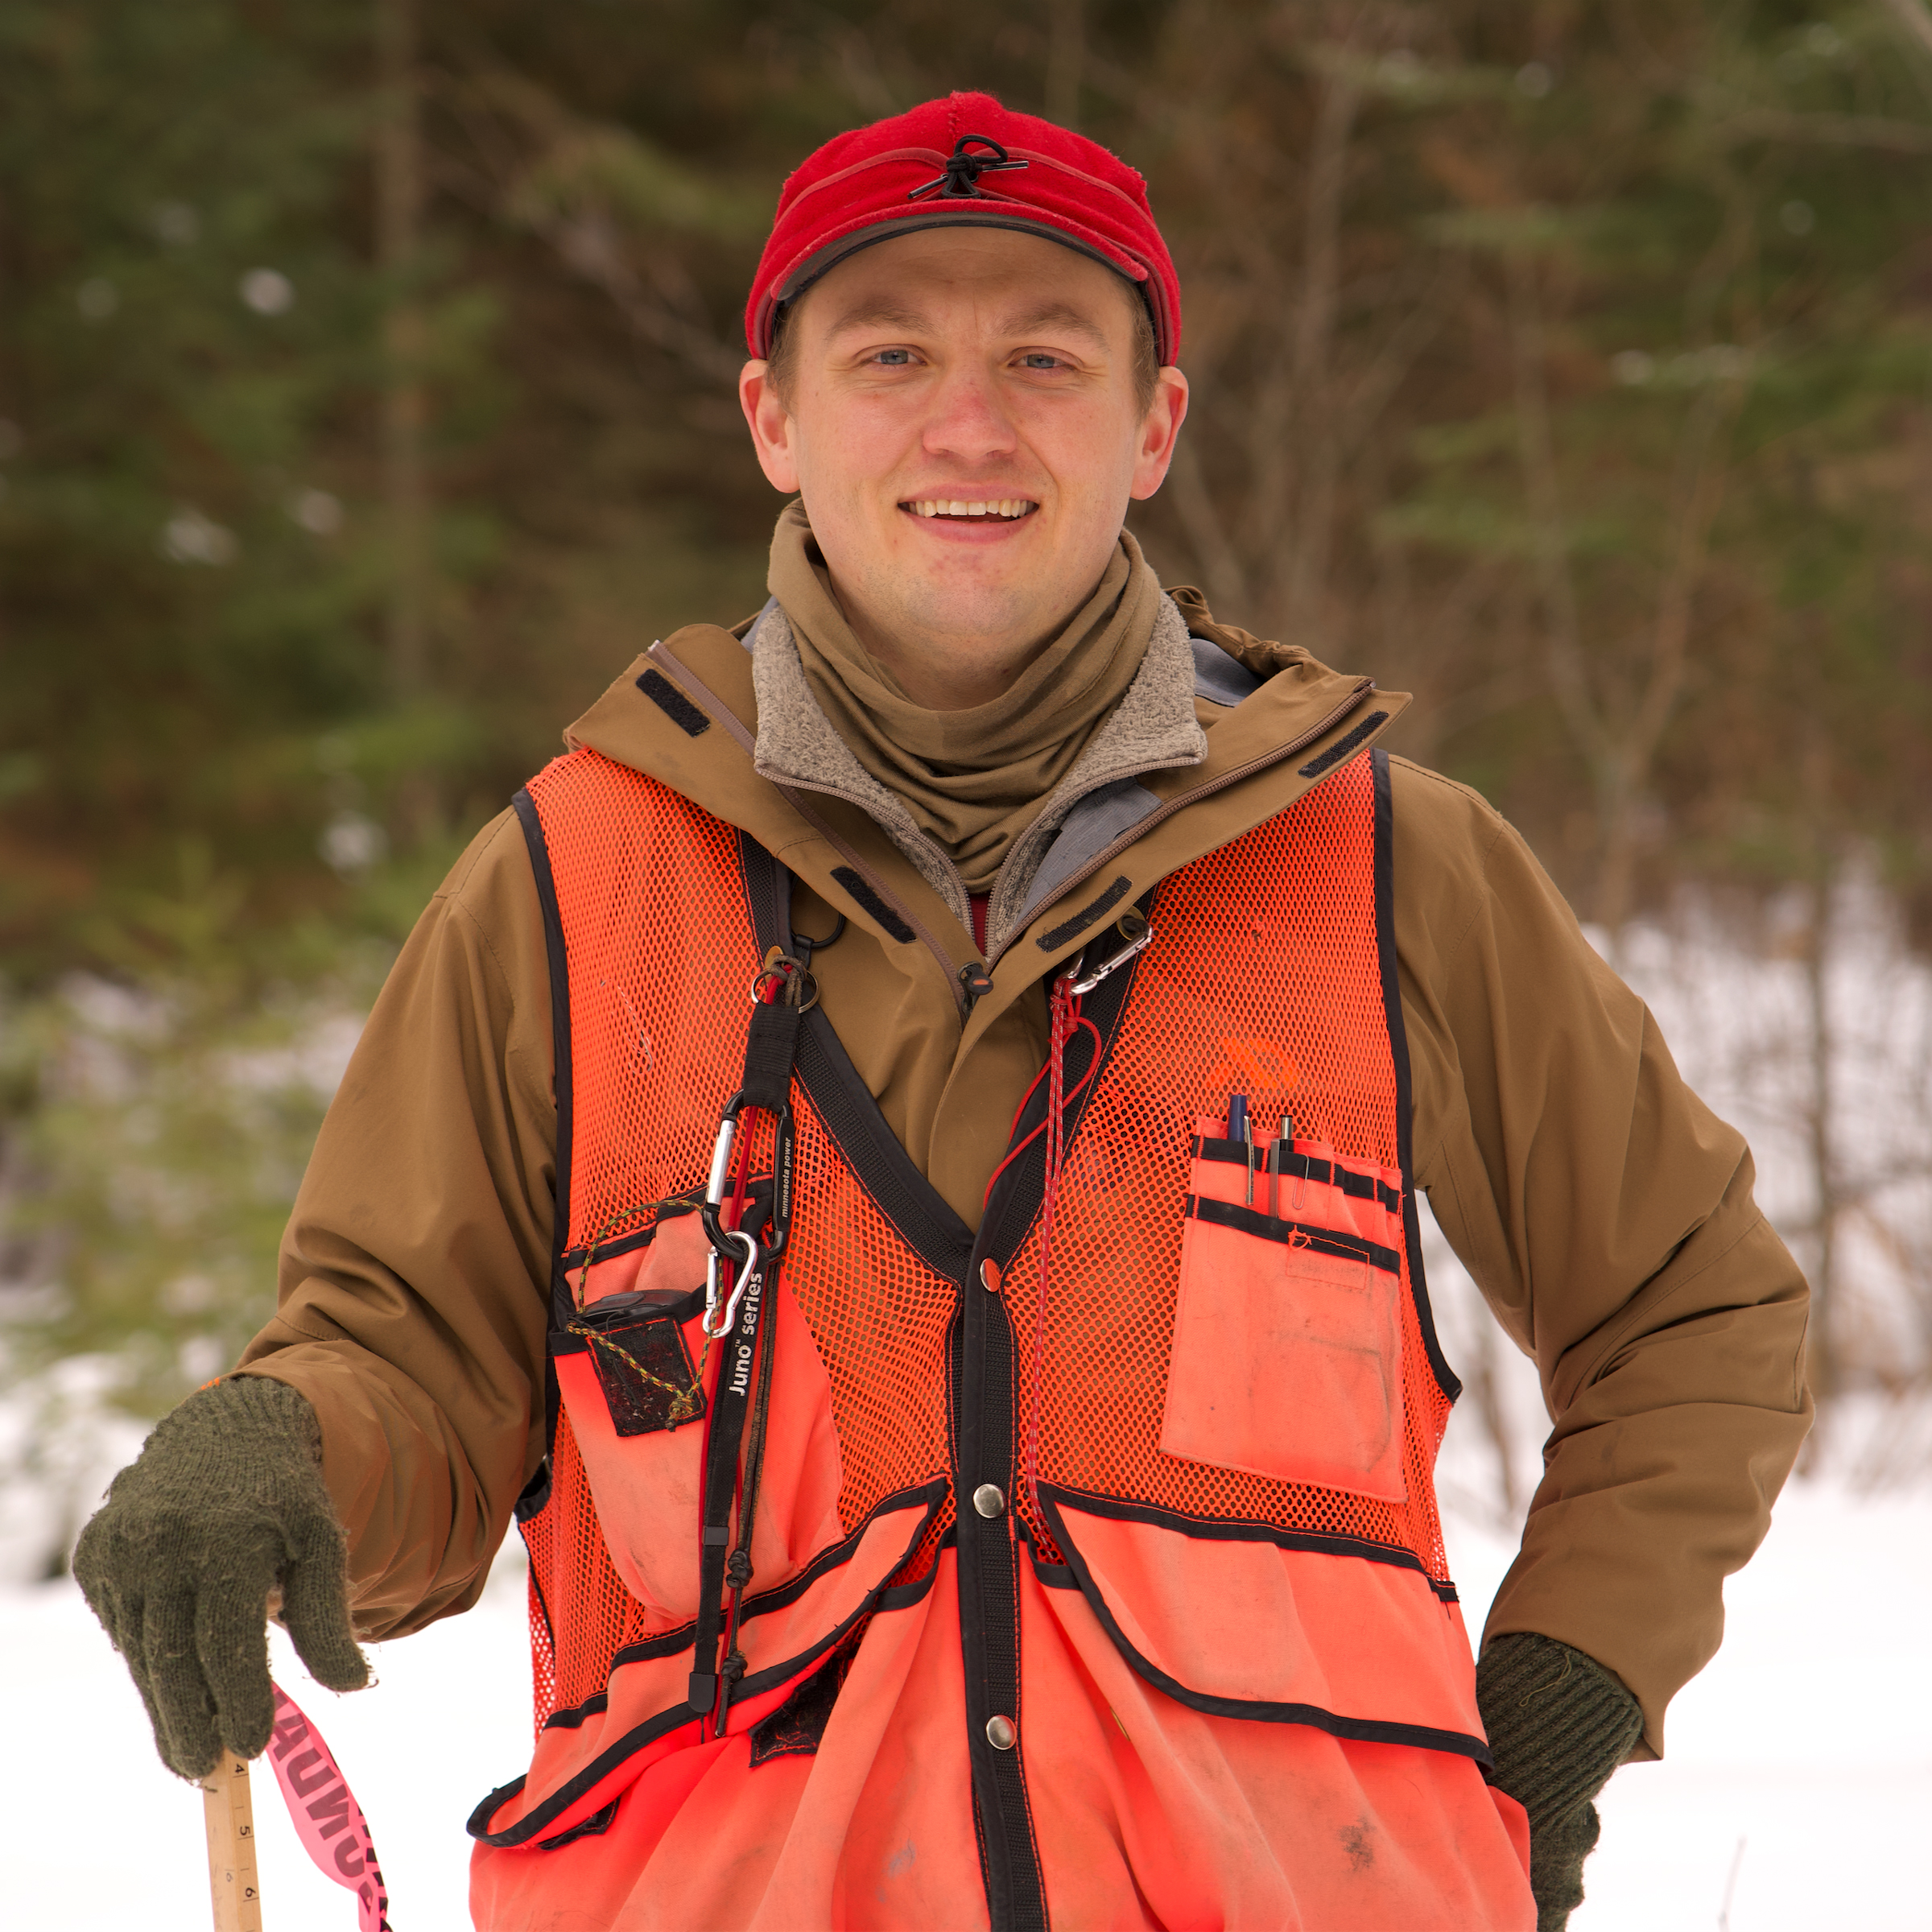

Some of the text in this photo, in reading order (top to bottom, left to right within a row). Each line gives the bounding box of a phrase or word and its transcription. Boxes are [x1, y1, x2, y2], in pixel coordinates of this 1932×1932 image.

[782, 1169, 791, 1218] minnesota
[741, 1273, 762, 1335] series
[234, 1763, 256, 1898] 4 5 6
